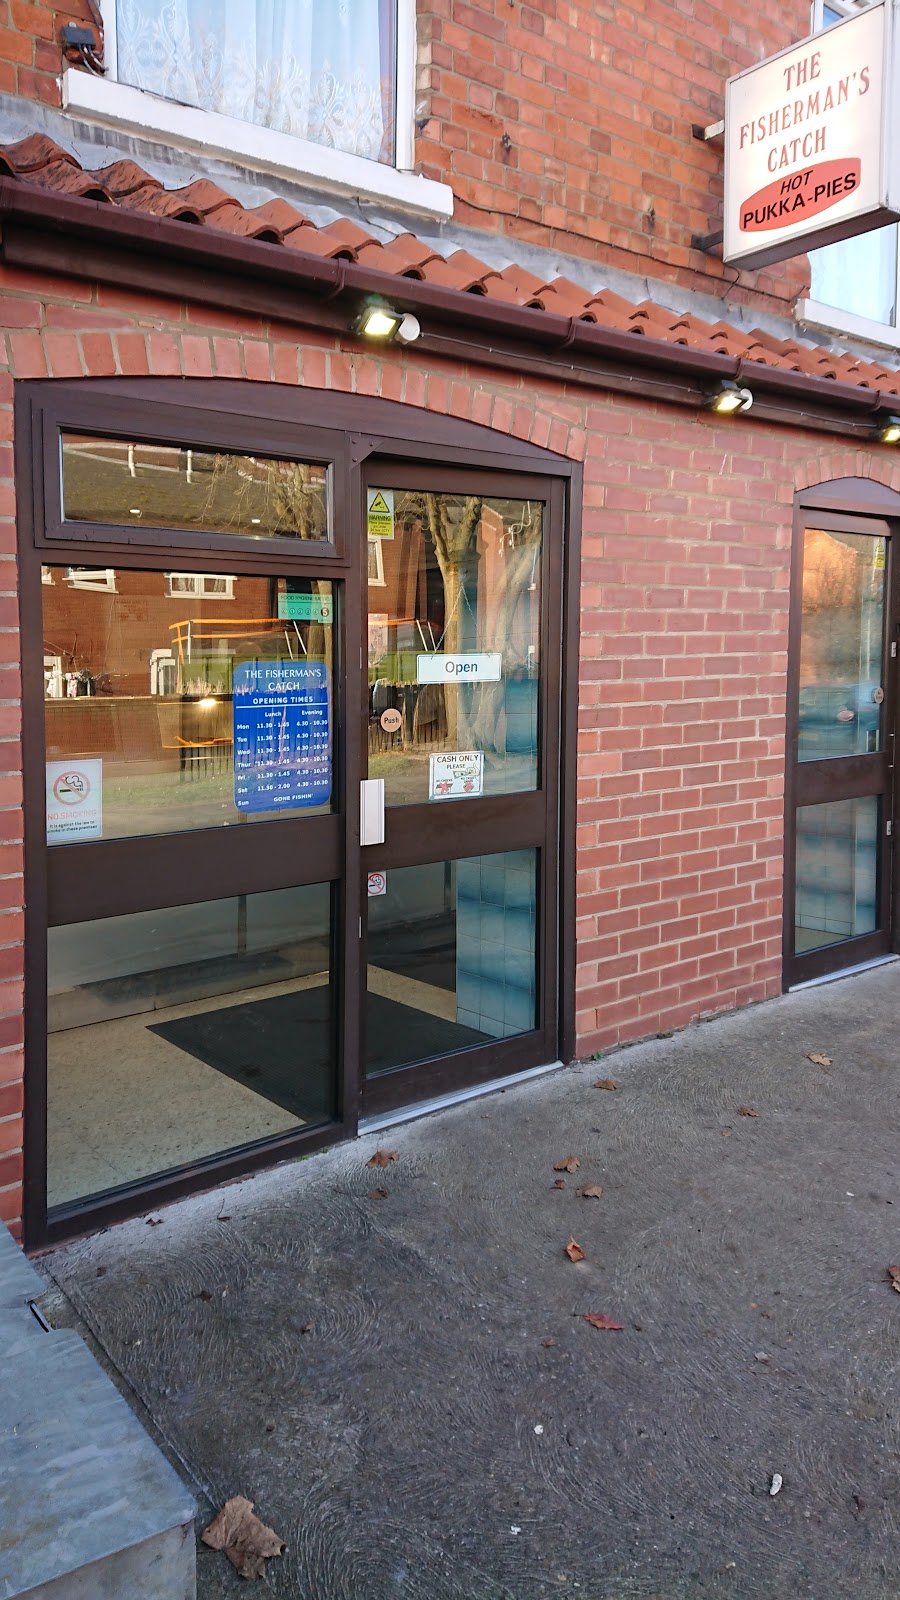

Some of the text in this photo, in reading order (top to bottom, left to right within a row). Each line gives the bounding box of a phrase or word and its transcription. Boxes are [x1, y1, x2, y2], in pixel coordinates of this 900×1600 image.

[783, 51, 822, 91] THE
[739, 66, 870, 150] FISHERMAN'S
[767, 126, 826, 173] CATCH
[780, 170, 814, 195] HOT
[743, 172, 856, 228] PUKKA-PIES
[244, 669, 321, 678] THE FISHERMAN'S
[445, 661, 478, 675] Open
[268, 682, 300, 691] CATCH
[60, 810, 96, 819] SMOKING
